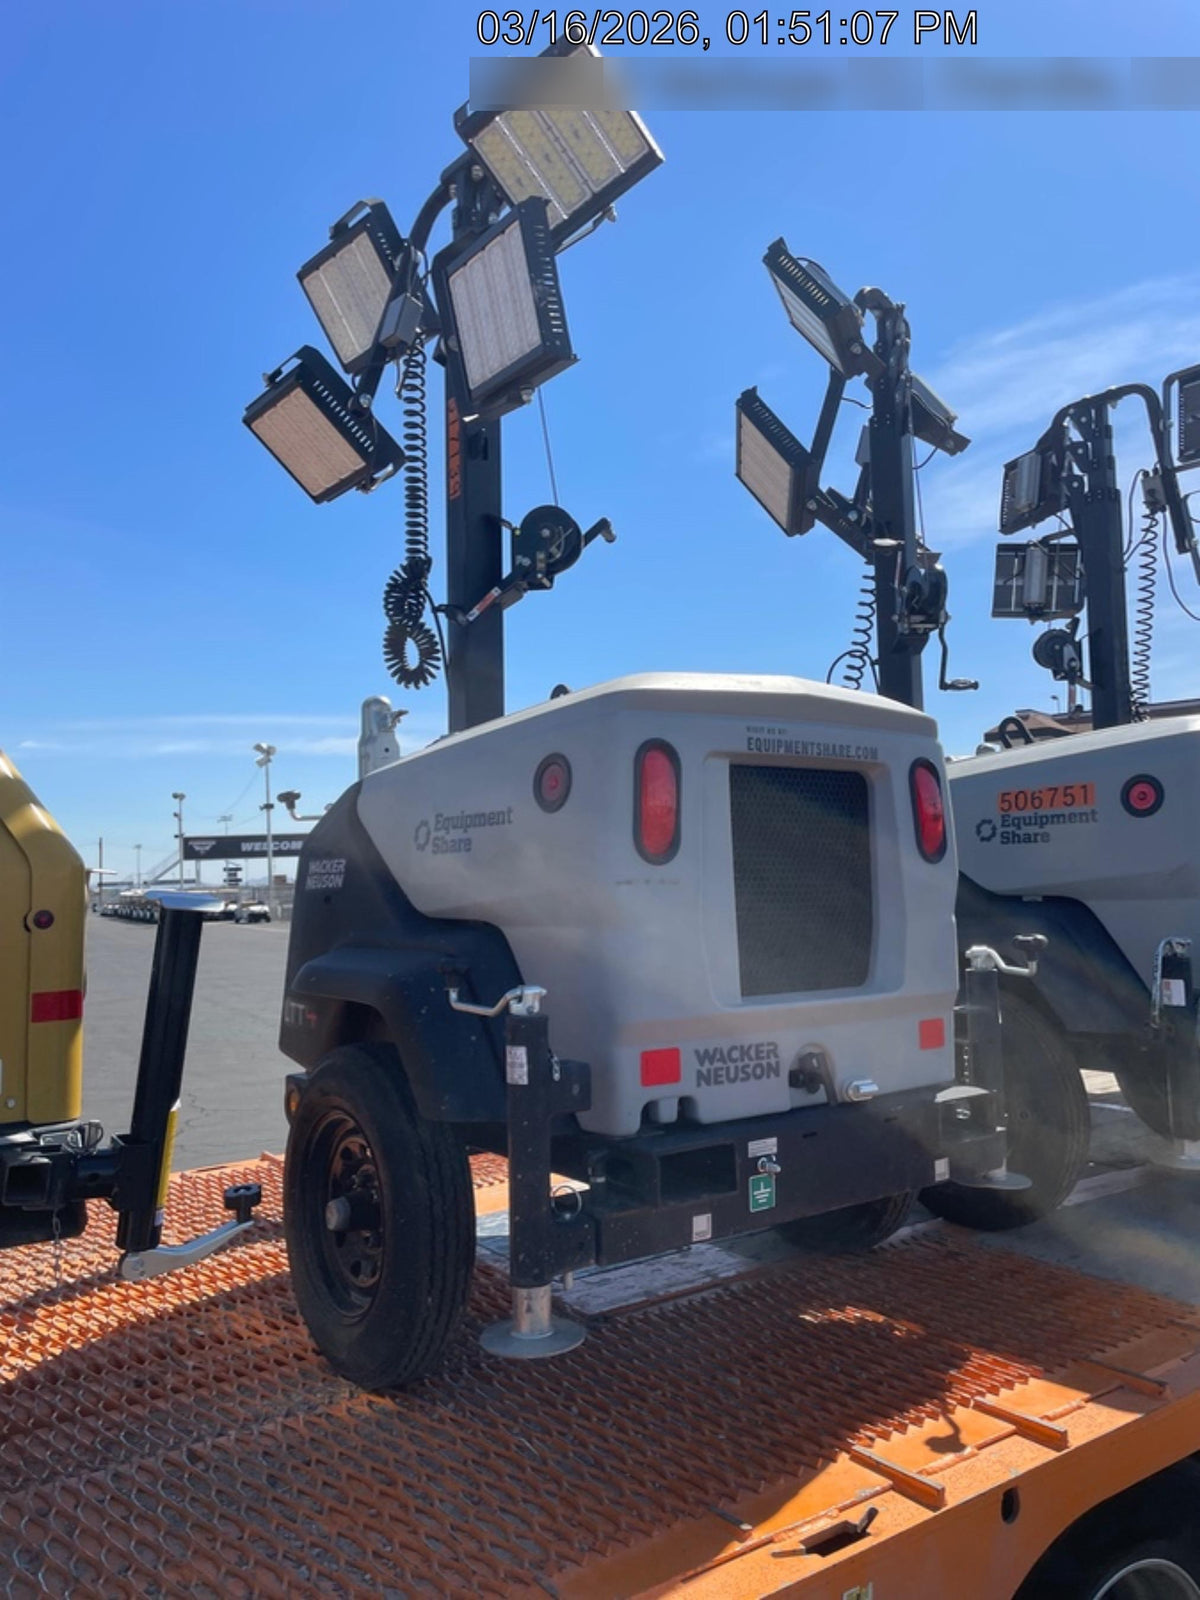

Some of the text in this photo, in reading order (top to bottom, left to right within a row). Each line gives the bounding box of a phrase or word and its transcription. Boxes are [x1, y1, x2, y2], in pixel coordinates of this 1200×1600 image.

[746, 736, 879, 761] EQUIPMENTSHARE.COM
[1000, 784, 1089, 813] 506751
[434, 806, 513, 833] Equipment
[1000, 808, 1099, 830] Equipment
[431, 835, 472, 855] Share
[1000, 829, 1051, 845] Share
[694, 1042, 780, 1067] WACKER
[696, 1060, 780, 1088] NEUSON
